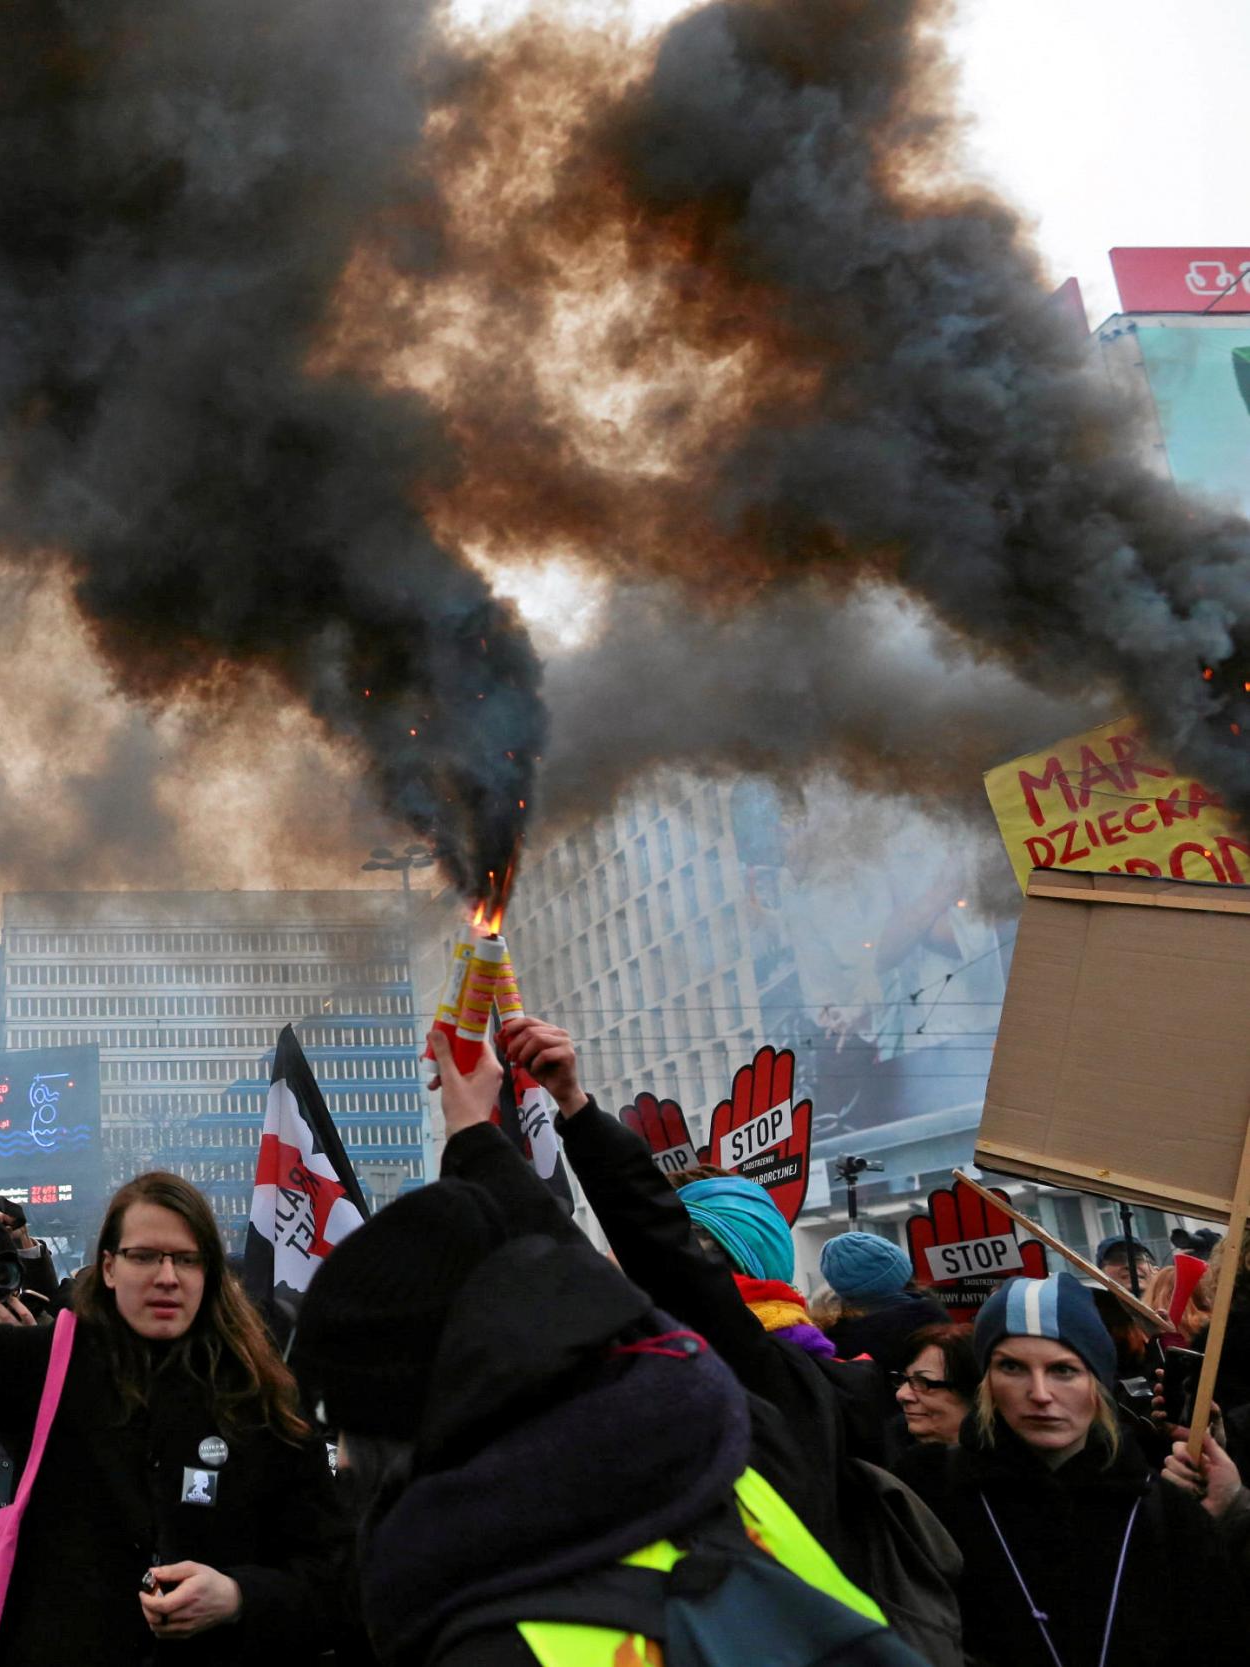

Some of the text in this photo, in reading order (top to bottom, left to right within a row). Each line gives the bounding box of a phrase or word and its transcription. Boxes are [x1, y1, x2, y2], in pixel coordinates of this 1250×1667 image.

[732, 1110, 783, 1161] STOP
[653, 1149, 688, 1173] OP
[941, 1239, 1008, 1274] STOP
